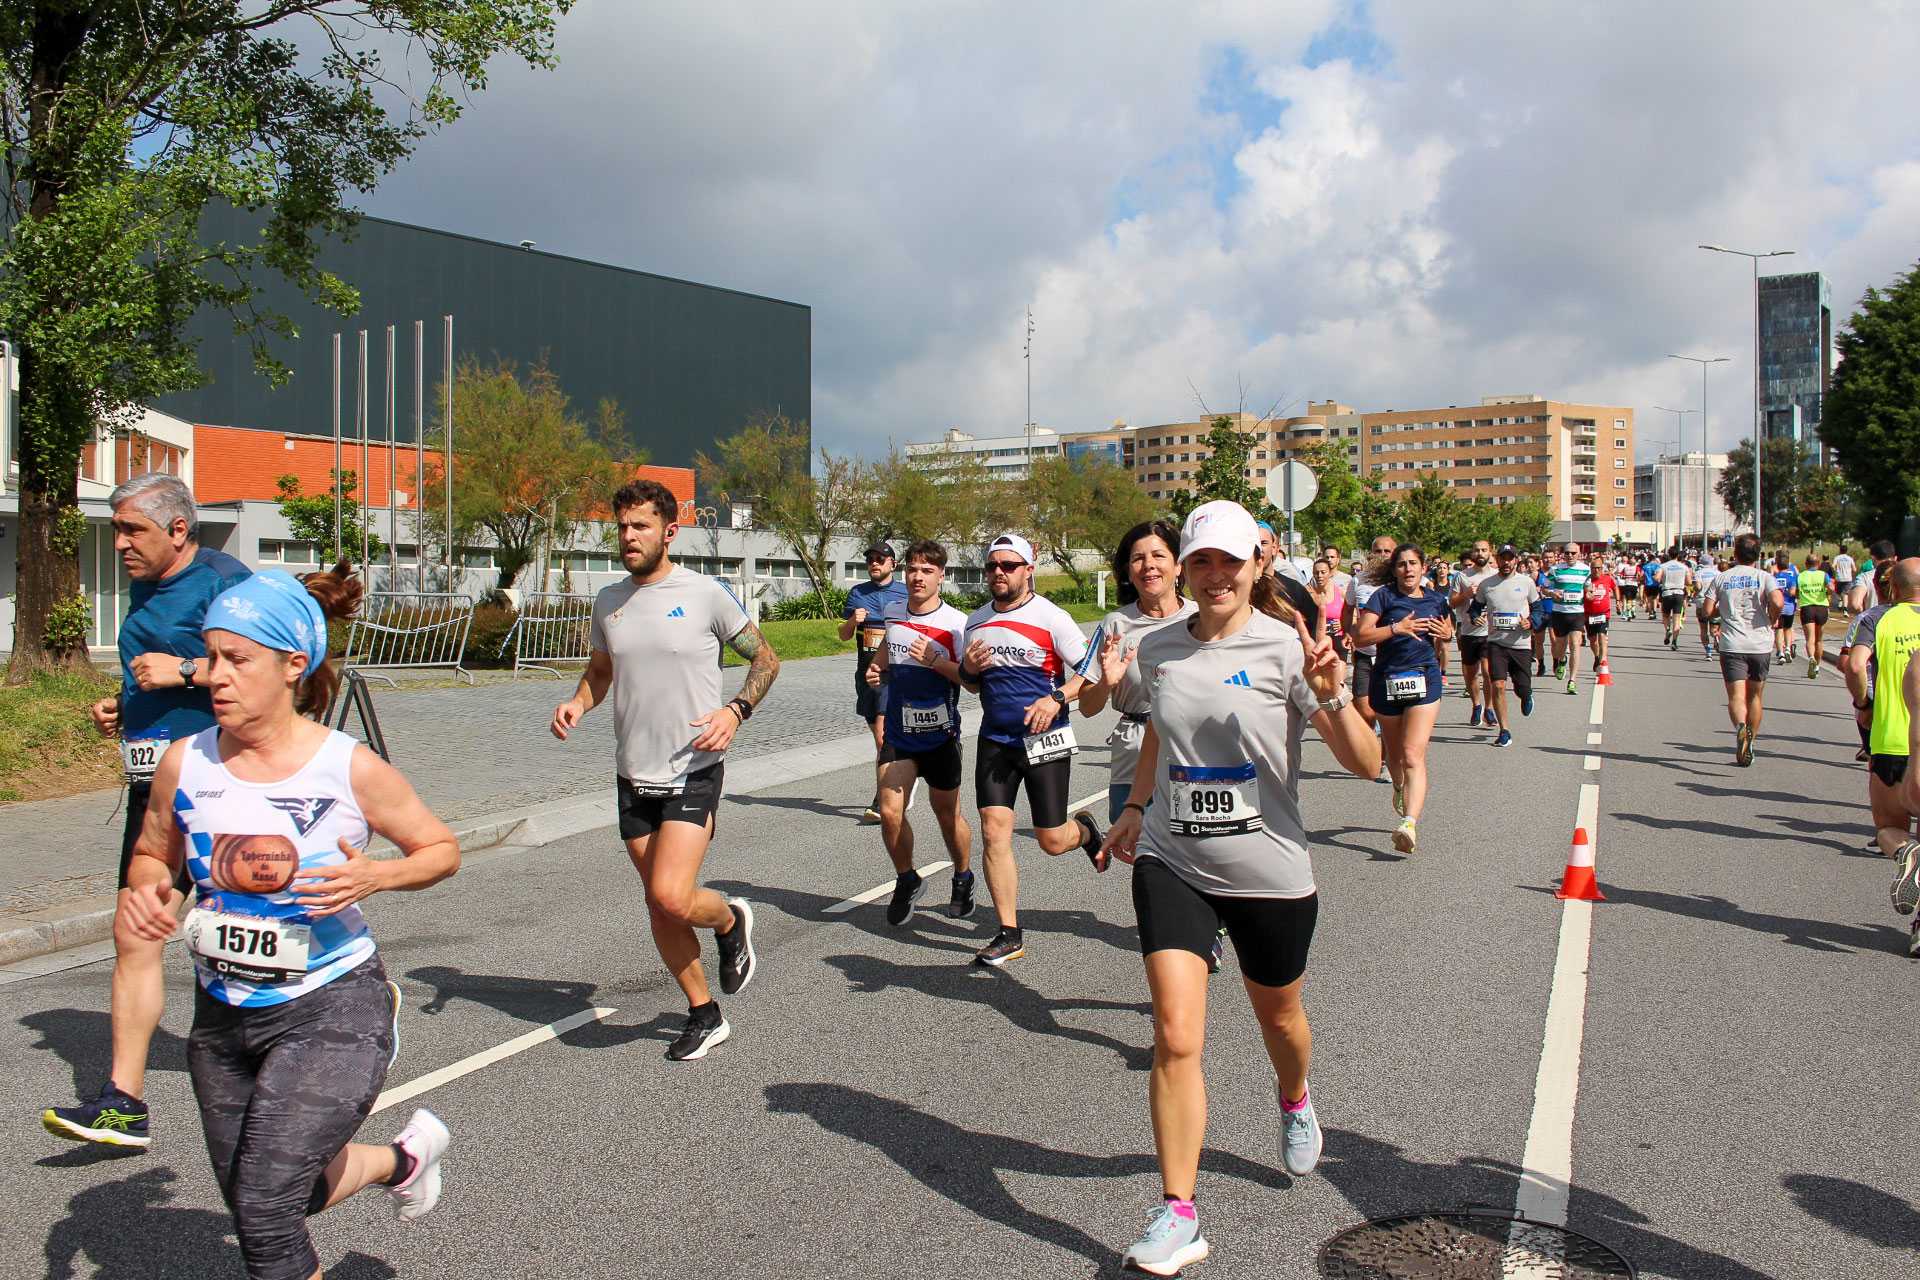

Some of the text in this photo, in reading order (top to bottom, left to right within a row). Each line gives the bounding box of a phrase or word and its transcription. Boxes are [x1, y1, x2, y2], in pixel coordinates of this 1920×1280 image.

[1395, 680, 1416, 691] 1448
[912, 711, 939, 723] 1445
[1039, 732, 1065, 749] 1431
[130, 747, 155, 766] 822
[1190, 790, 1234, 814] 899
[216, 924, 278, 957] 1578
